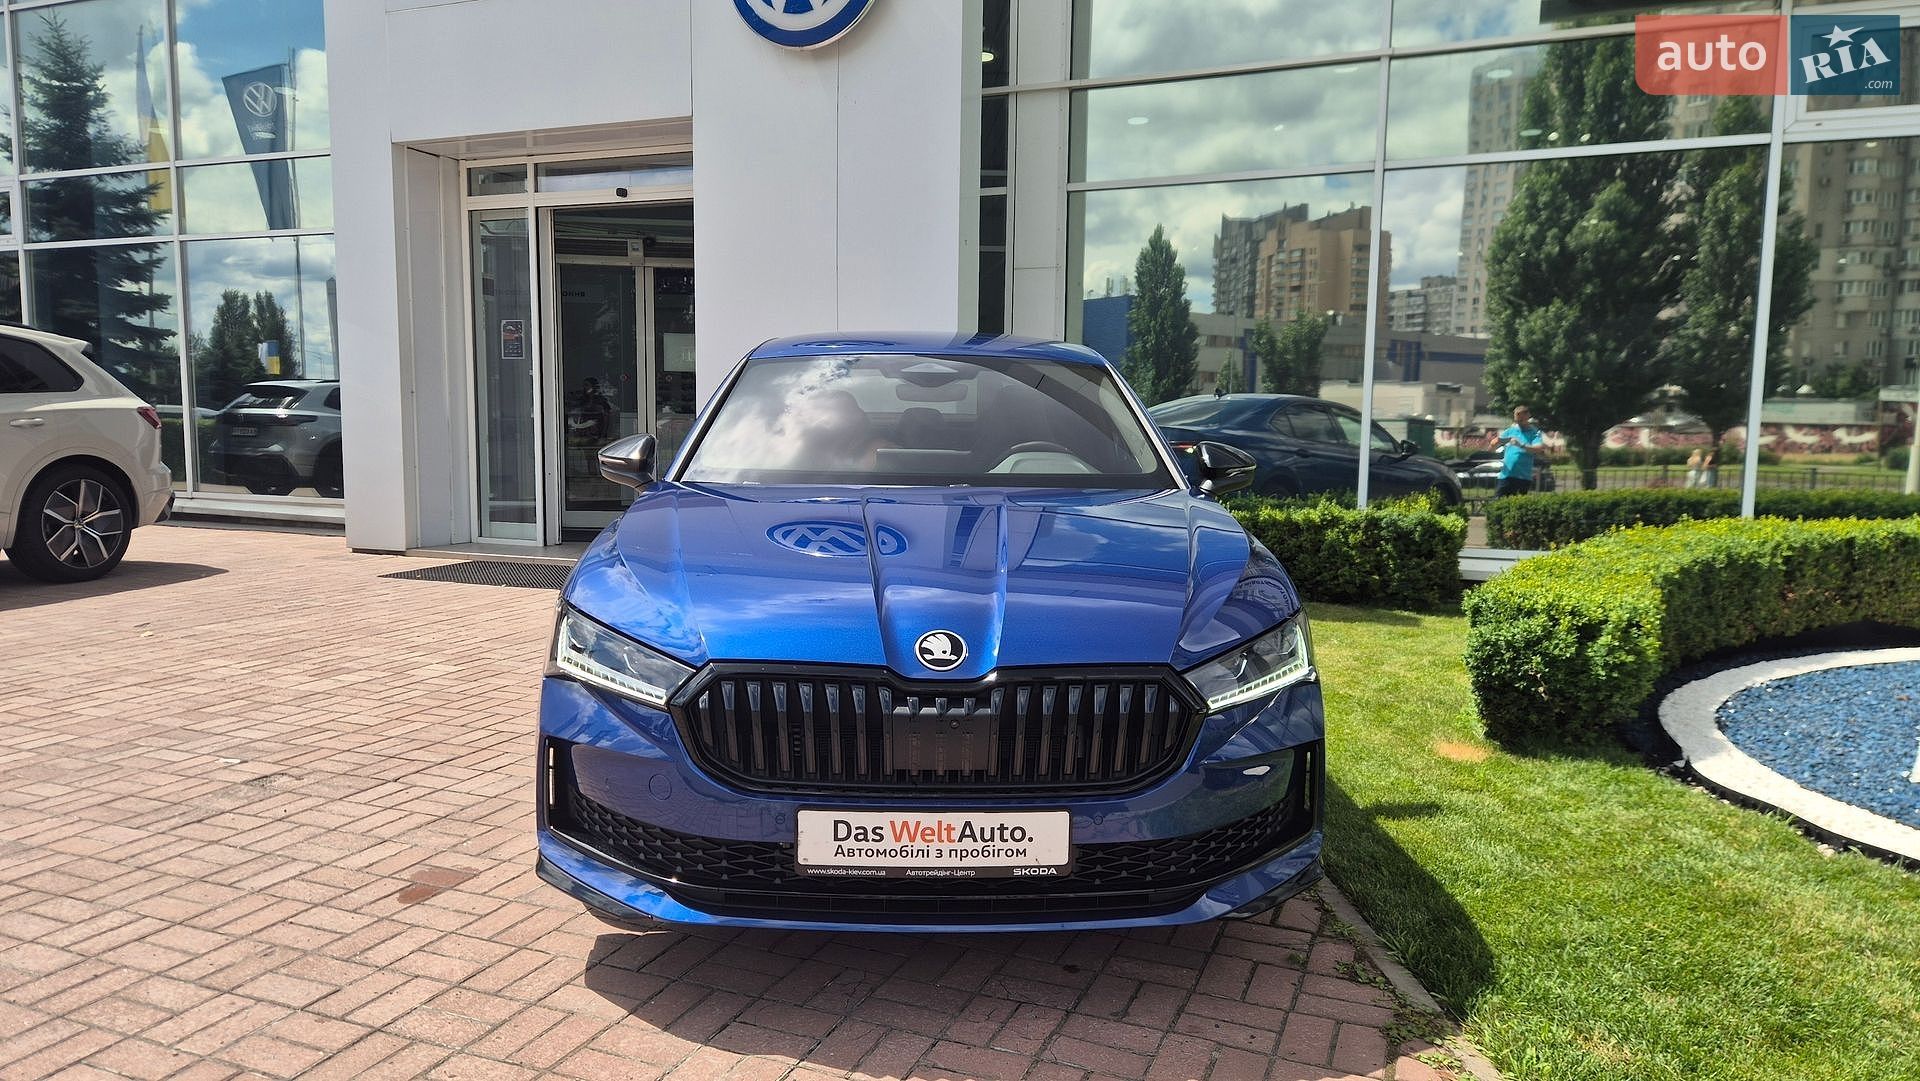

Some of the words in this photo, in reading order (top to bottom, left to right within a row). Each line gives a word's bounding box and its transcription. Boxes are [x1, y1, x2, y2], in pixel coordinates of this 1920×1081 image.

[833, 819, 884, 843] Das
[890, 819, 1034, 843] WeltAuto.
[834, 845, 929, 859] Автомобілі
[935, 847, 943, 858] з
[949, 845, 1027, 861] пробігом
[807, 868, 886, 876] www.skoda-kiev.com.ua
